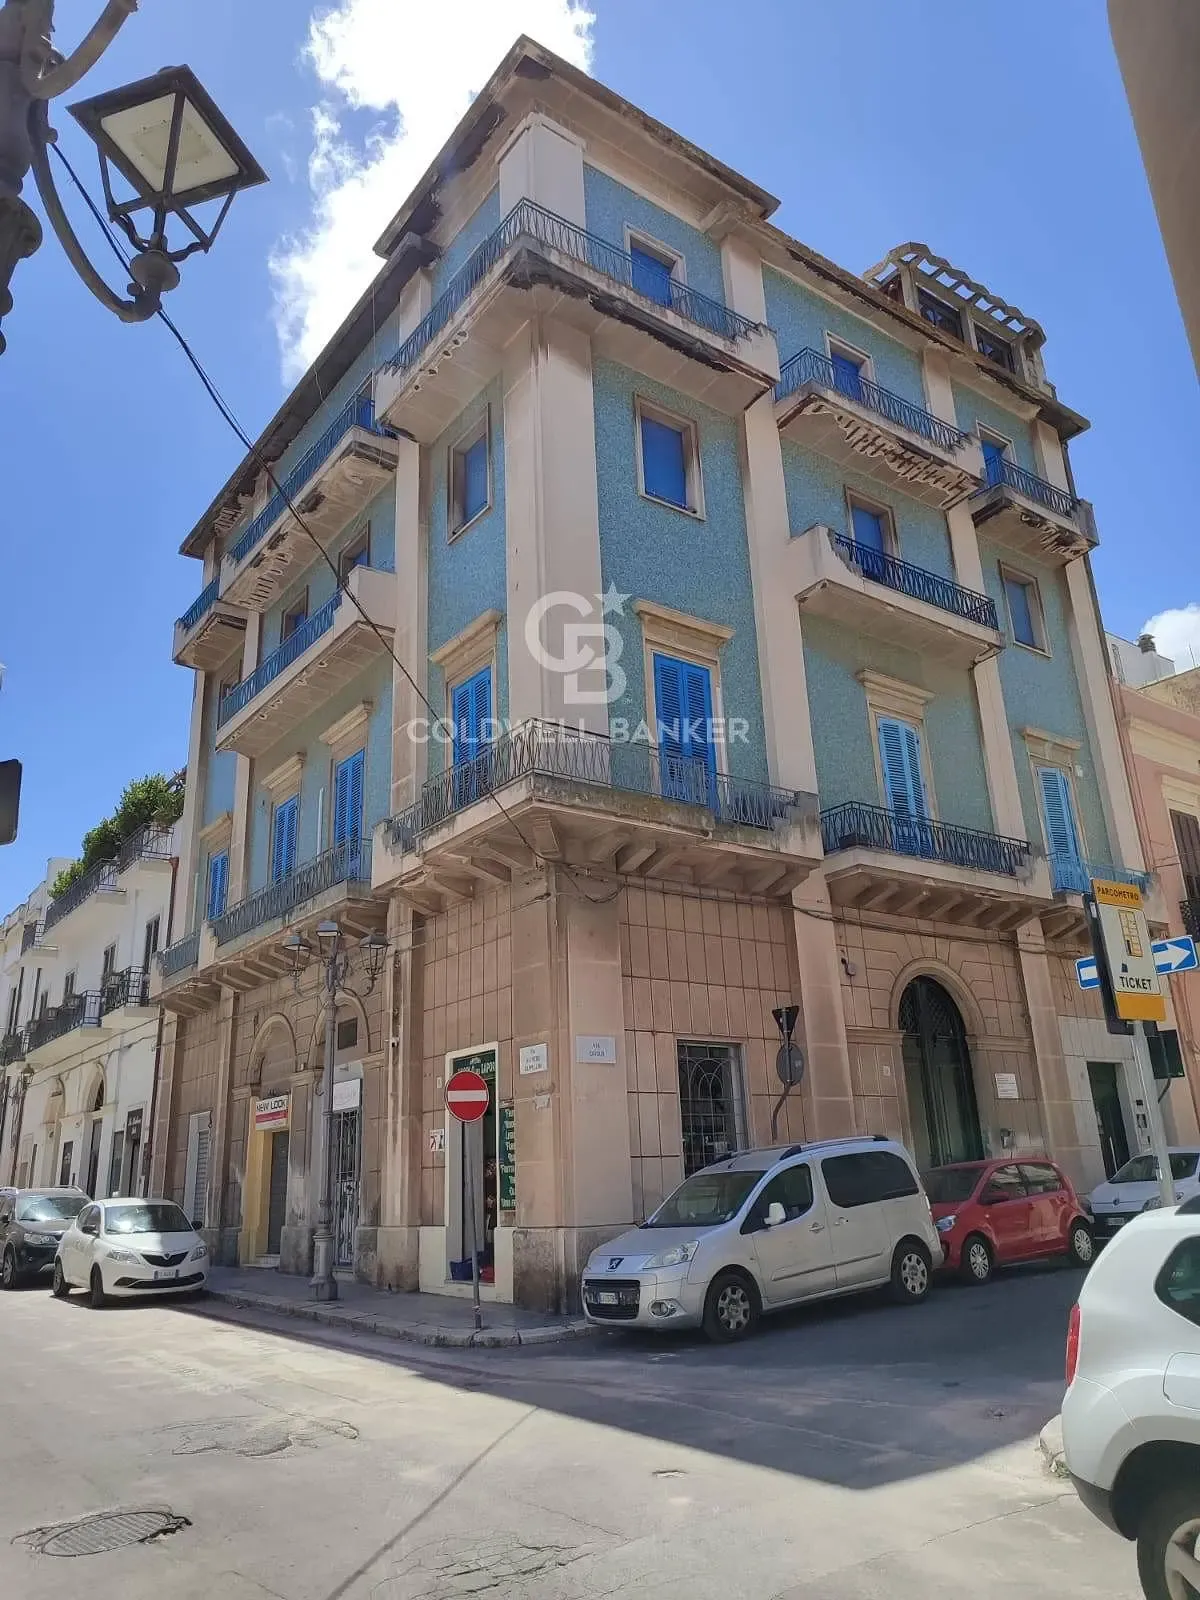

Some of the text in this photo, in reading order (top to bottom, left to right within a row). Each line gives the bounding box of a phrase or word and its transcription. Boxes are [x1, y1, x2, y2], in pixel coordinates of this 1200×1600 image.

[1096, 886, 1140, 901] PARCOMETRO
[1119, 975, 1152, 991] TICKET
[256, 1099, 287, 1112] NEW LOOK
